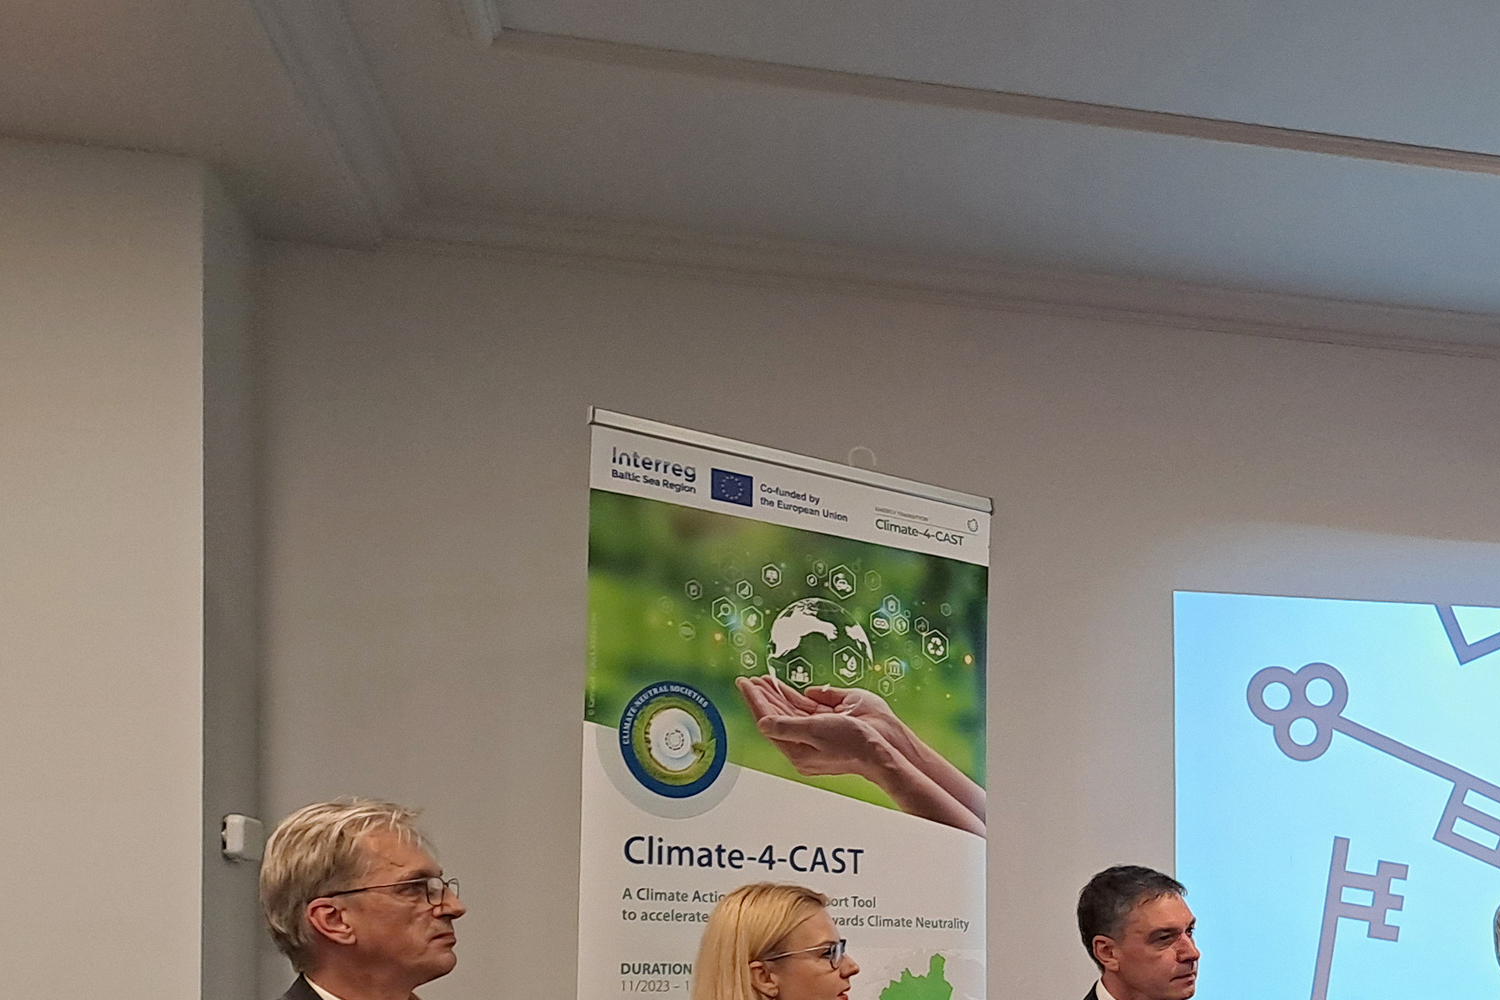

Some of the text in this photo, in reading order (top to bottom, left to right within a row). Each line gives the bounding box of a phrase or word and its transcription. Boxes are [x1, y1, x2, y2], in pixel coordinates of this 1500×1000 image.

[612, 446, 697, 482] Interreg
[611, 469, 697, 494] Baltic Sea Region
[759, 483, 821, 506] Co-funded by
[759, 496, 848, 523] the European Union
[875, 518, 965, 546] Climate-4-CAST
[623, 835, 865, 875] Climate-4-CAST
[621, 887, 633, 901] A
[636, 887, 689, 903] Climate
[692, 889, 726, 904] Actio
[850, 895, 877, 909] Tool
[622, 909, 637, 921] to
[640, 909, 709, 923] accelerate
[867, 915, 913, 928] Climate
[915, 916, 970, 933] Neutrality
[620, 962, 693, 976] DURATION
[621, 979, 670, 993] 11/2023
